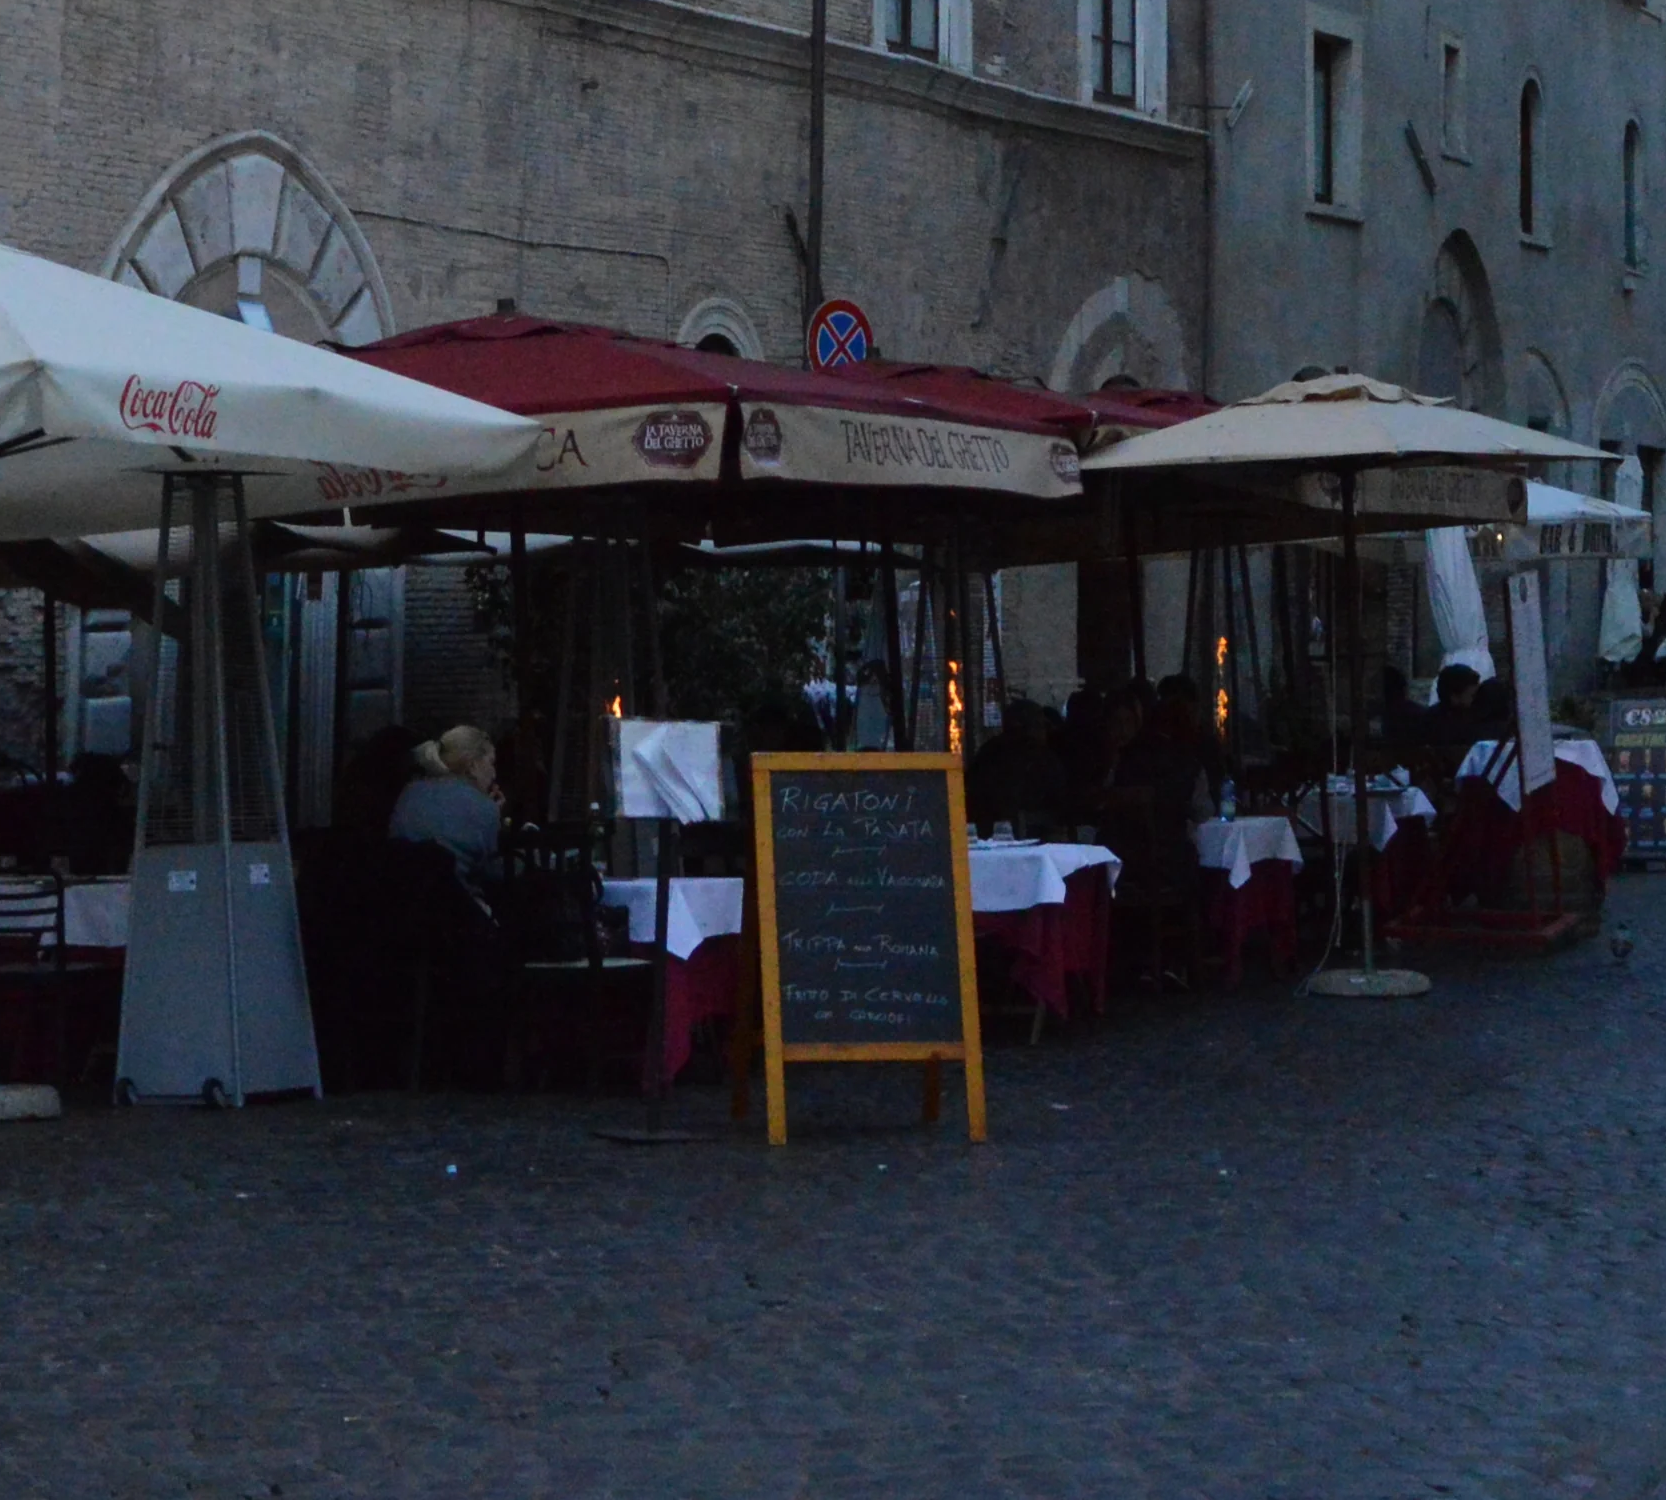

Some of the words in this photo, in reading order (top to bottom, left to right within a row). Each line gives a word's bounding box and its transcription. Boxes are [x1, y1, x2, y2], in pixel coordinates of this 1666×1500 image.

[658, 423, 704, 437] TAVERNA
[664, 436, 704, 449] GHETTO
[840, 419, 920, 467] TAVERNA
